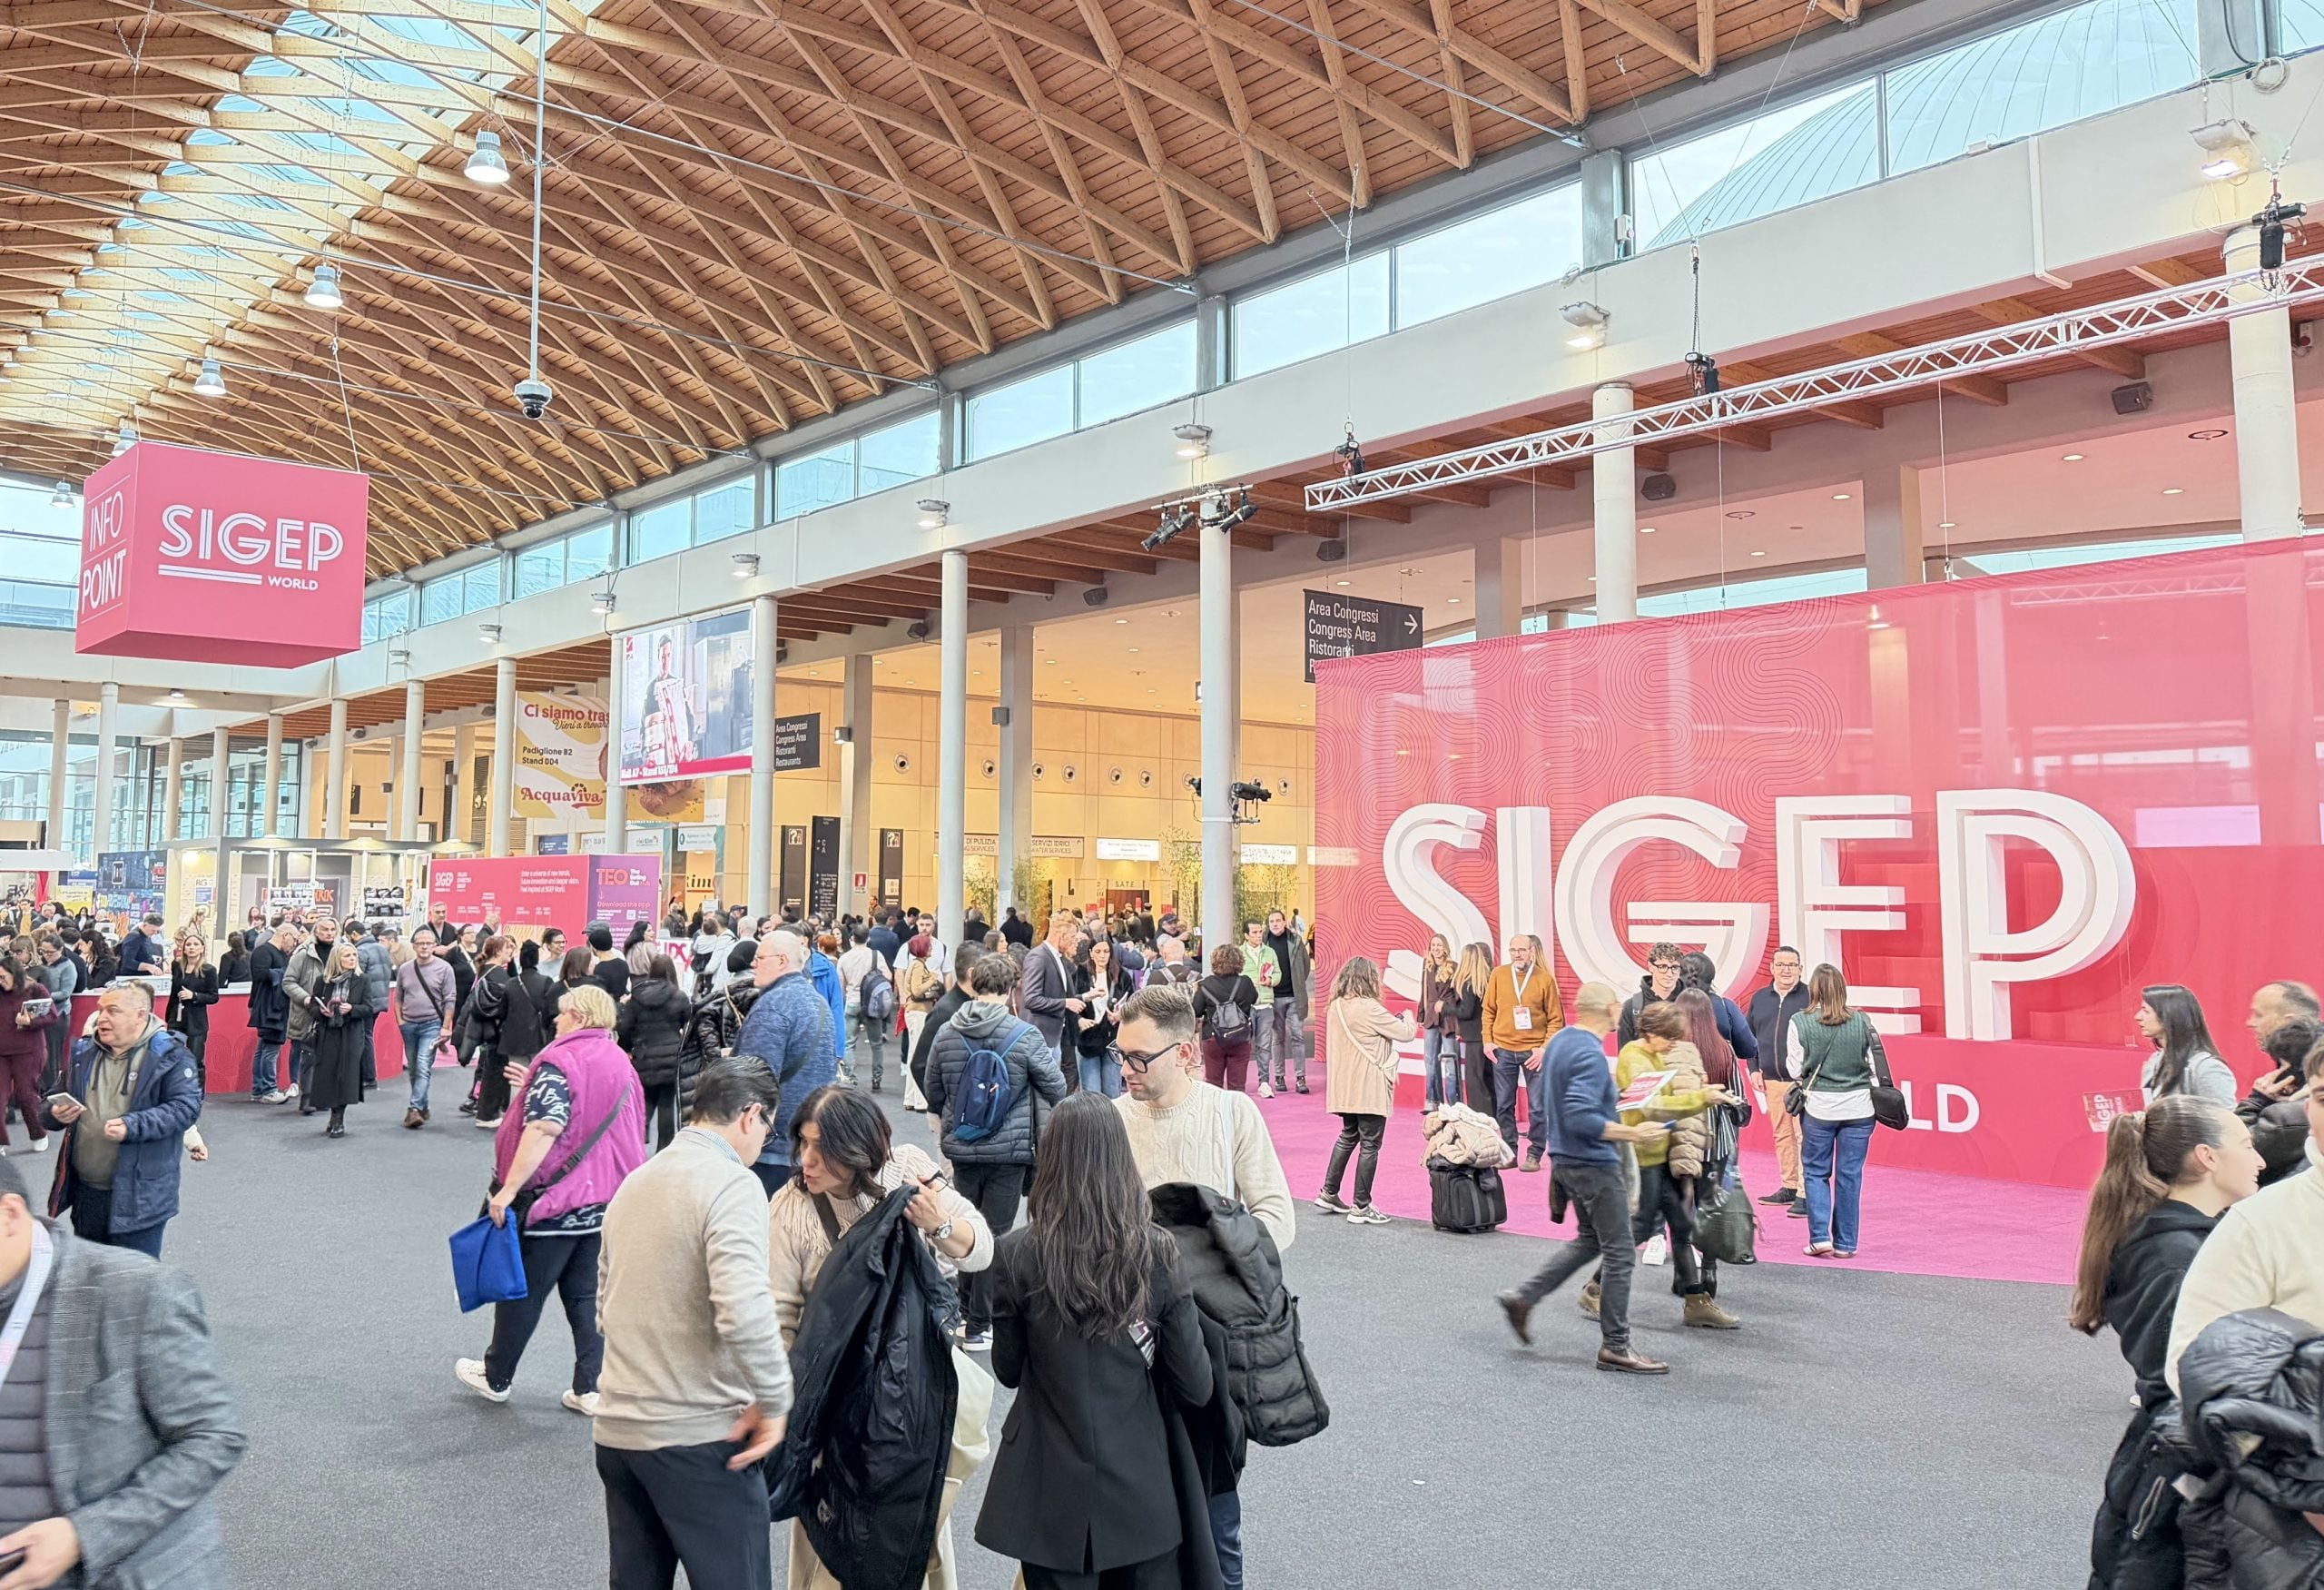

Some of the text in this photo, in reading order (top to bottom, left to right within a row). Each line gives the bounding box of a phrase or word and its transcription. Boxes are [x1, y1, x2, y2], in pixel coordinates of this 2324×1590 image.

[89, 490, 123, 552] INFO
[158, 504, 344, 571] SIGEP
[82, 548, 126, 615] POINT
[267, 575, 319, 591] WORLD
[1308, 598, 1379, 624] Area Congressi
[1308, 618, 1376, 643] Congress Area
[524, 704, 539, 717] Ci
[541, 705, 585, 720] siamo
[552, 718, 576, 730] Vieni
[775, 720, 808, 733] Area Congressi
[775, 733, 807, 746] Congress Area
[522, 746, 562, 756] Padiglione
[775, 745, 797, 755] Ristoranti
[522, 756, 544, 765] Stand
[775, 757, 802, 767] Restaurants
[520, 785, 604, 806] Acquaviva
[973, 837, 996, 845] PULIZIA
[596, 868, 629, 885] TEO
[1384, 788, 2137, 1041] SIGEP
